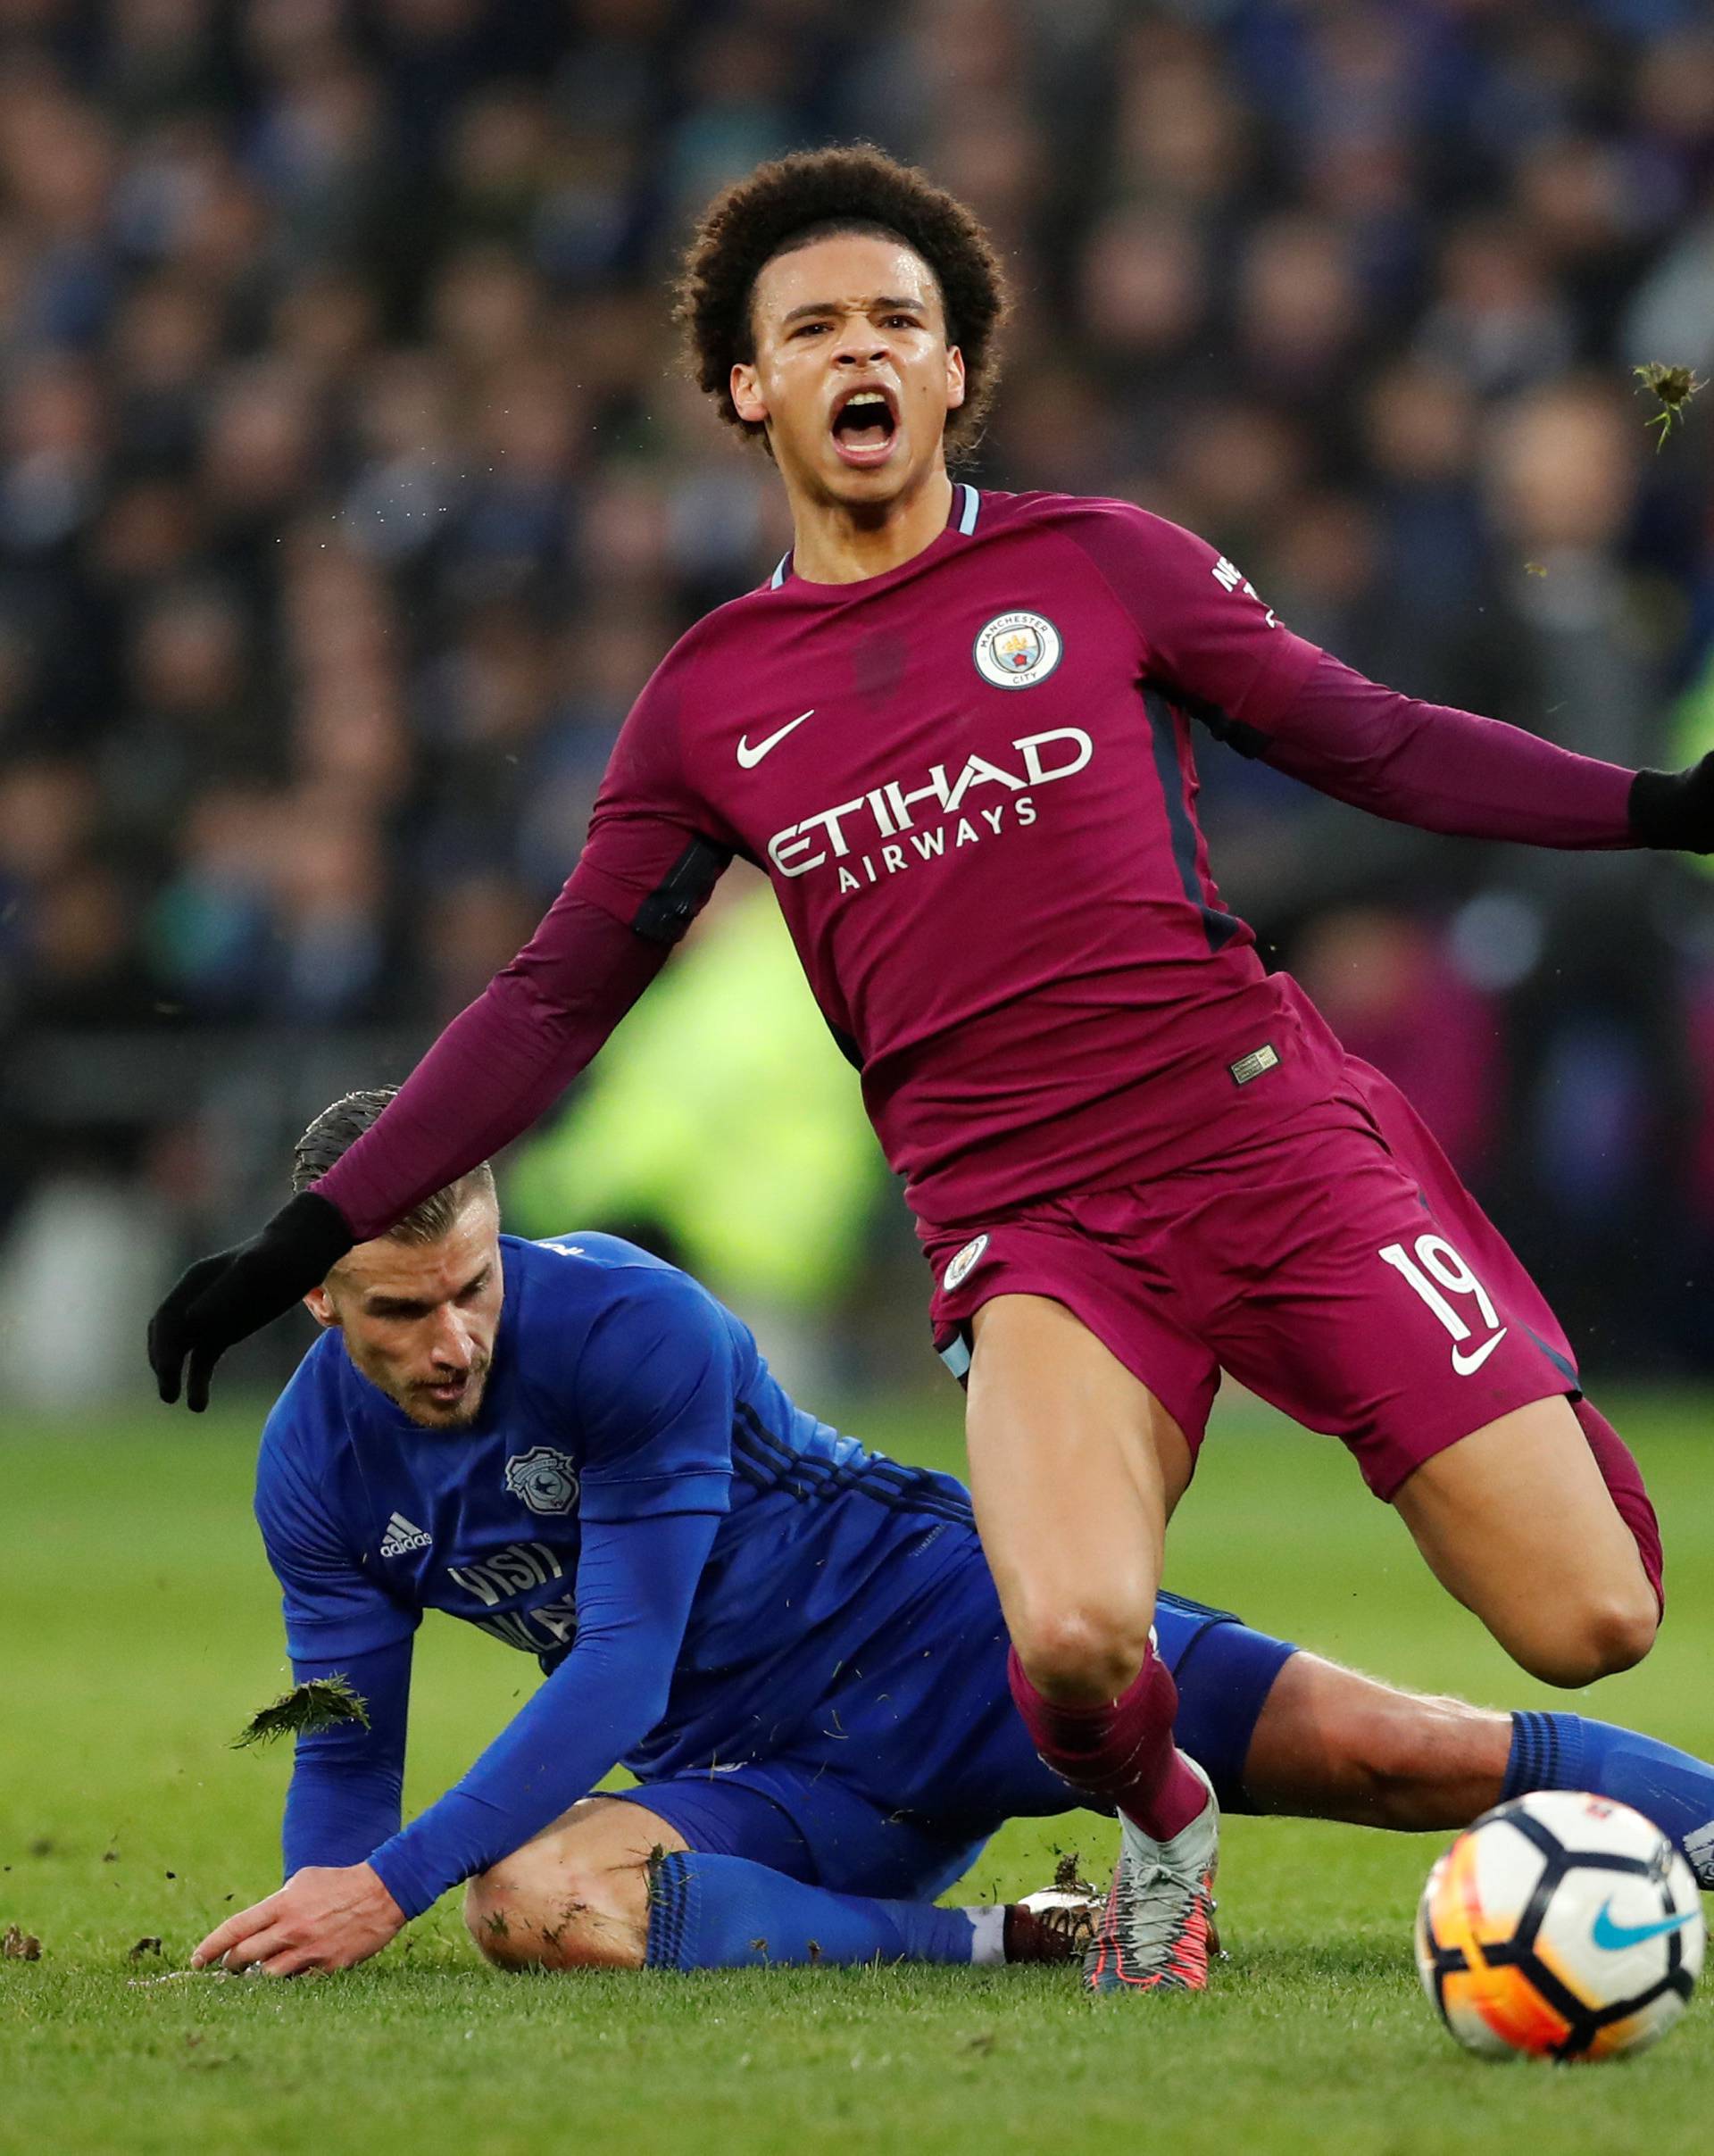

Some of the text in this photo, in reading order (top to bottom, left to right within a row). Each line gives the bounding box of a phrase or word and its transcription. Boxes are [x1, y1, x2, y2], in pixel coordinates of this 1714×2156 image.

[980, 616, 1049, 647] MANCHESTER
[1012, 671, 1037, 684] CITY
[767, 727, 1094, 878] ETIHAD
[838, 797, 1036, 894] AIRWAYS
[1378, 1234, 1500, 1341] 19
[380, 1532, 433, 1558] adidas
[447, 1543, 563, 1606] VISIT
